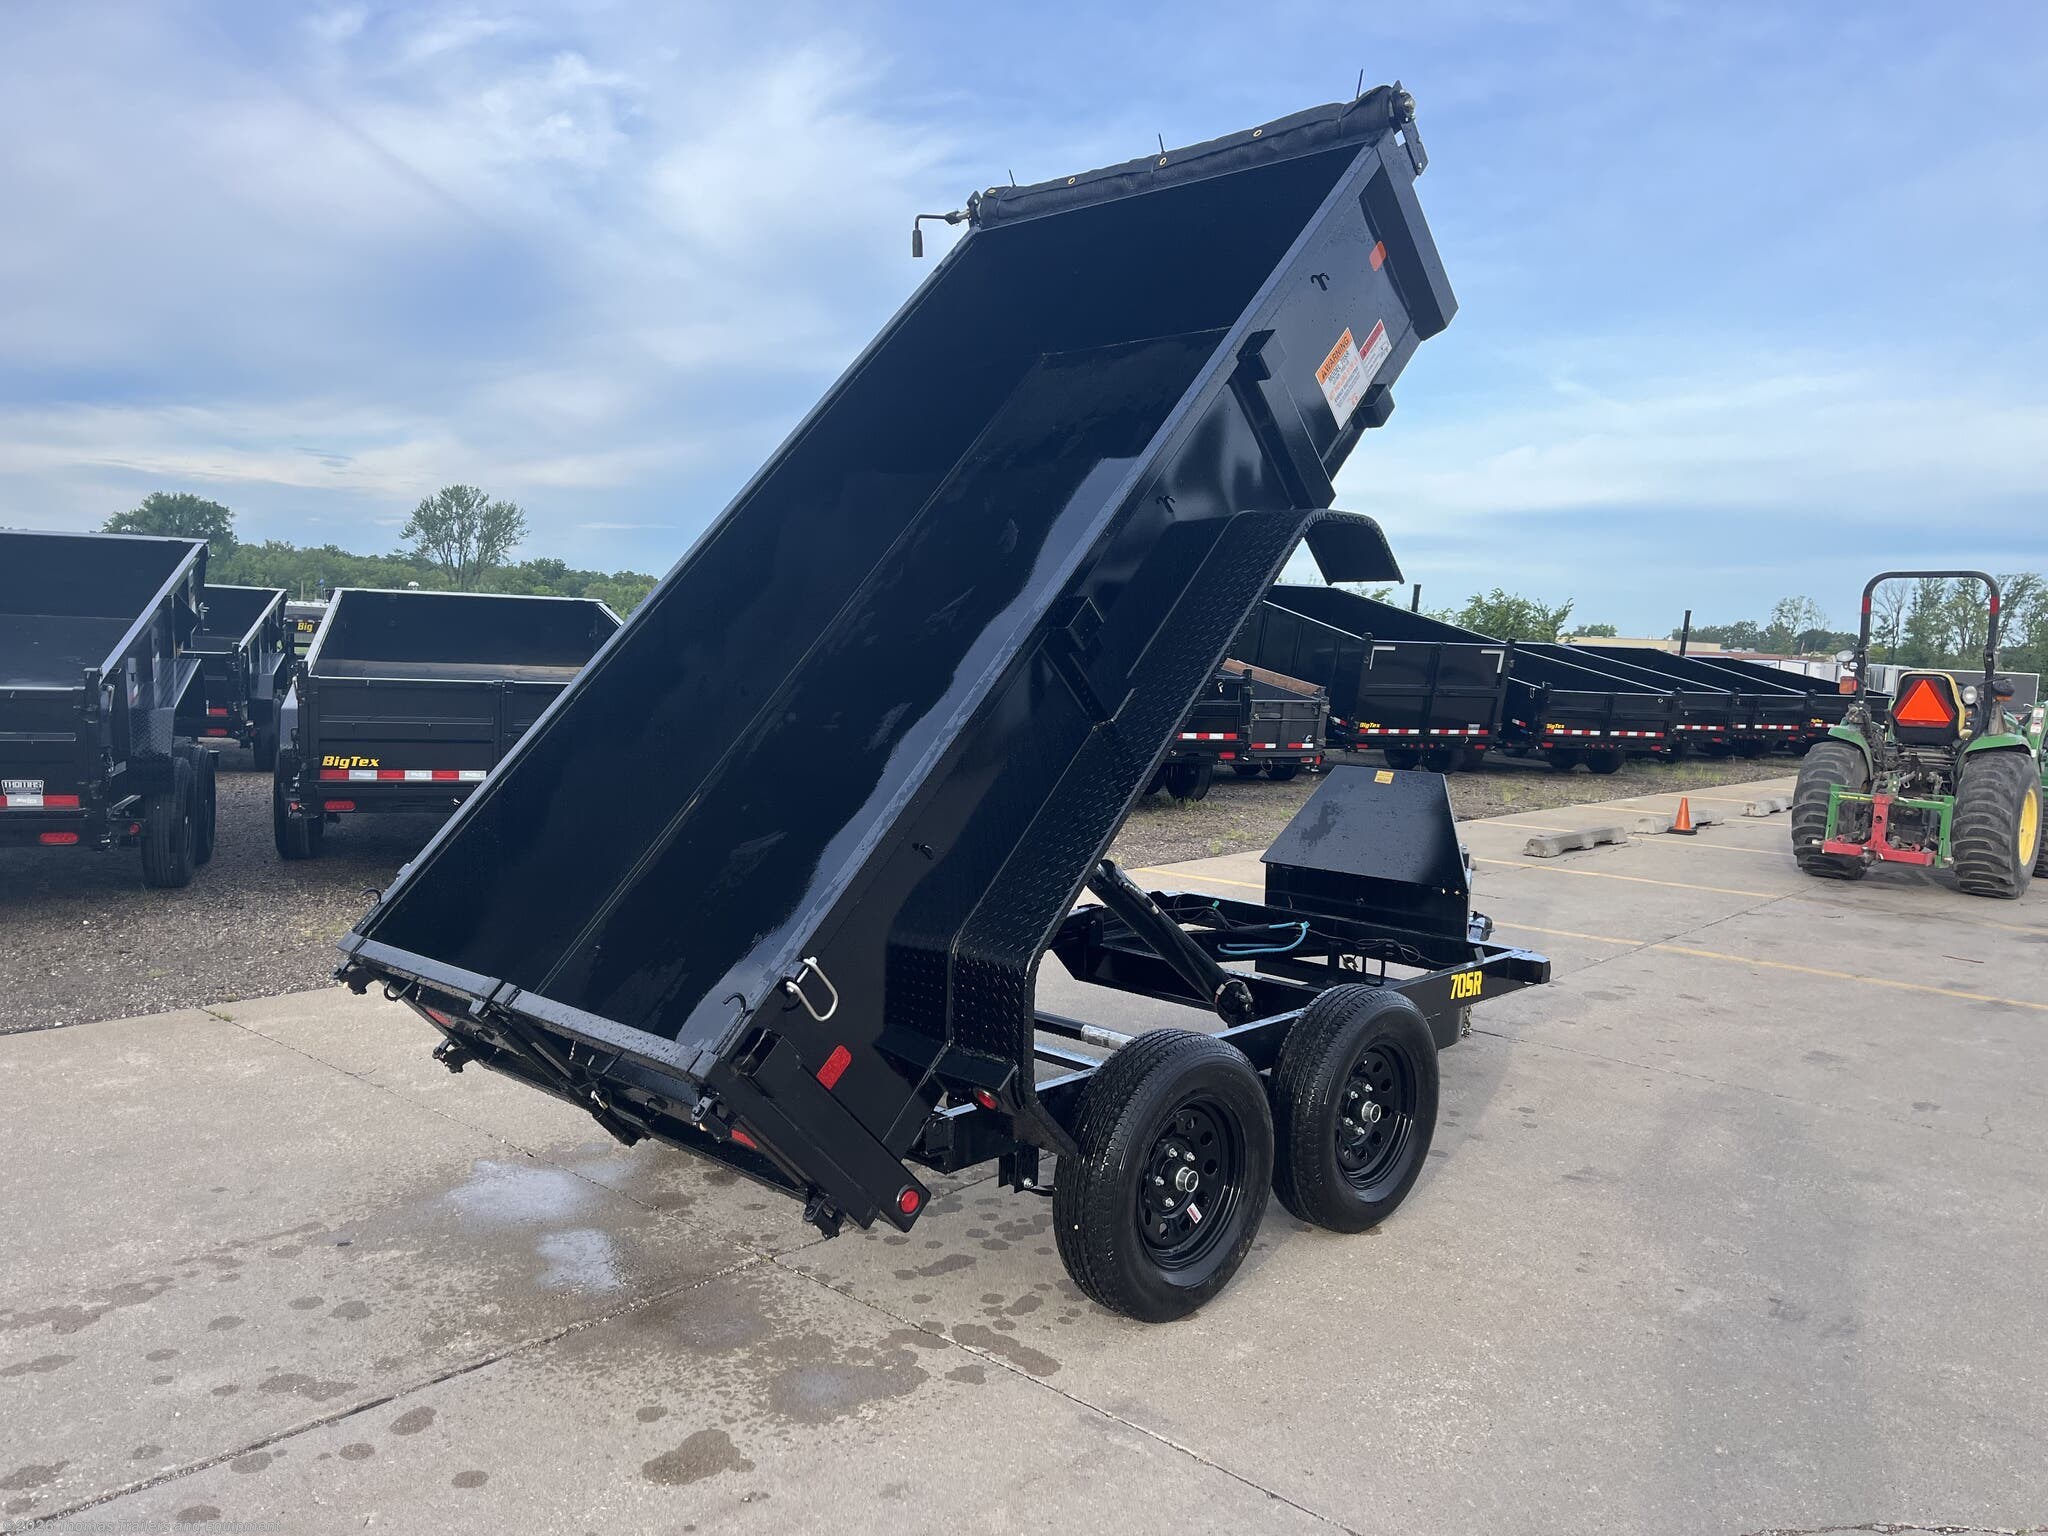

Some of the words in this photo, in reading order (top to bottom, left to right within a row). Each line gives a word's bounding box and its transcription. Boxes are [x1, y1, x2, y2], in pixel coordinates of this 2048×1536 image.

[1324, 336, 1349, 372] WARNING
[297, 622, 313, 633] Big
[322, 755, 380, 769] BigTex
